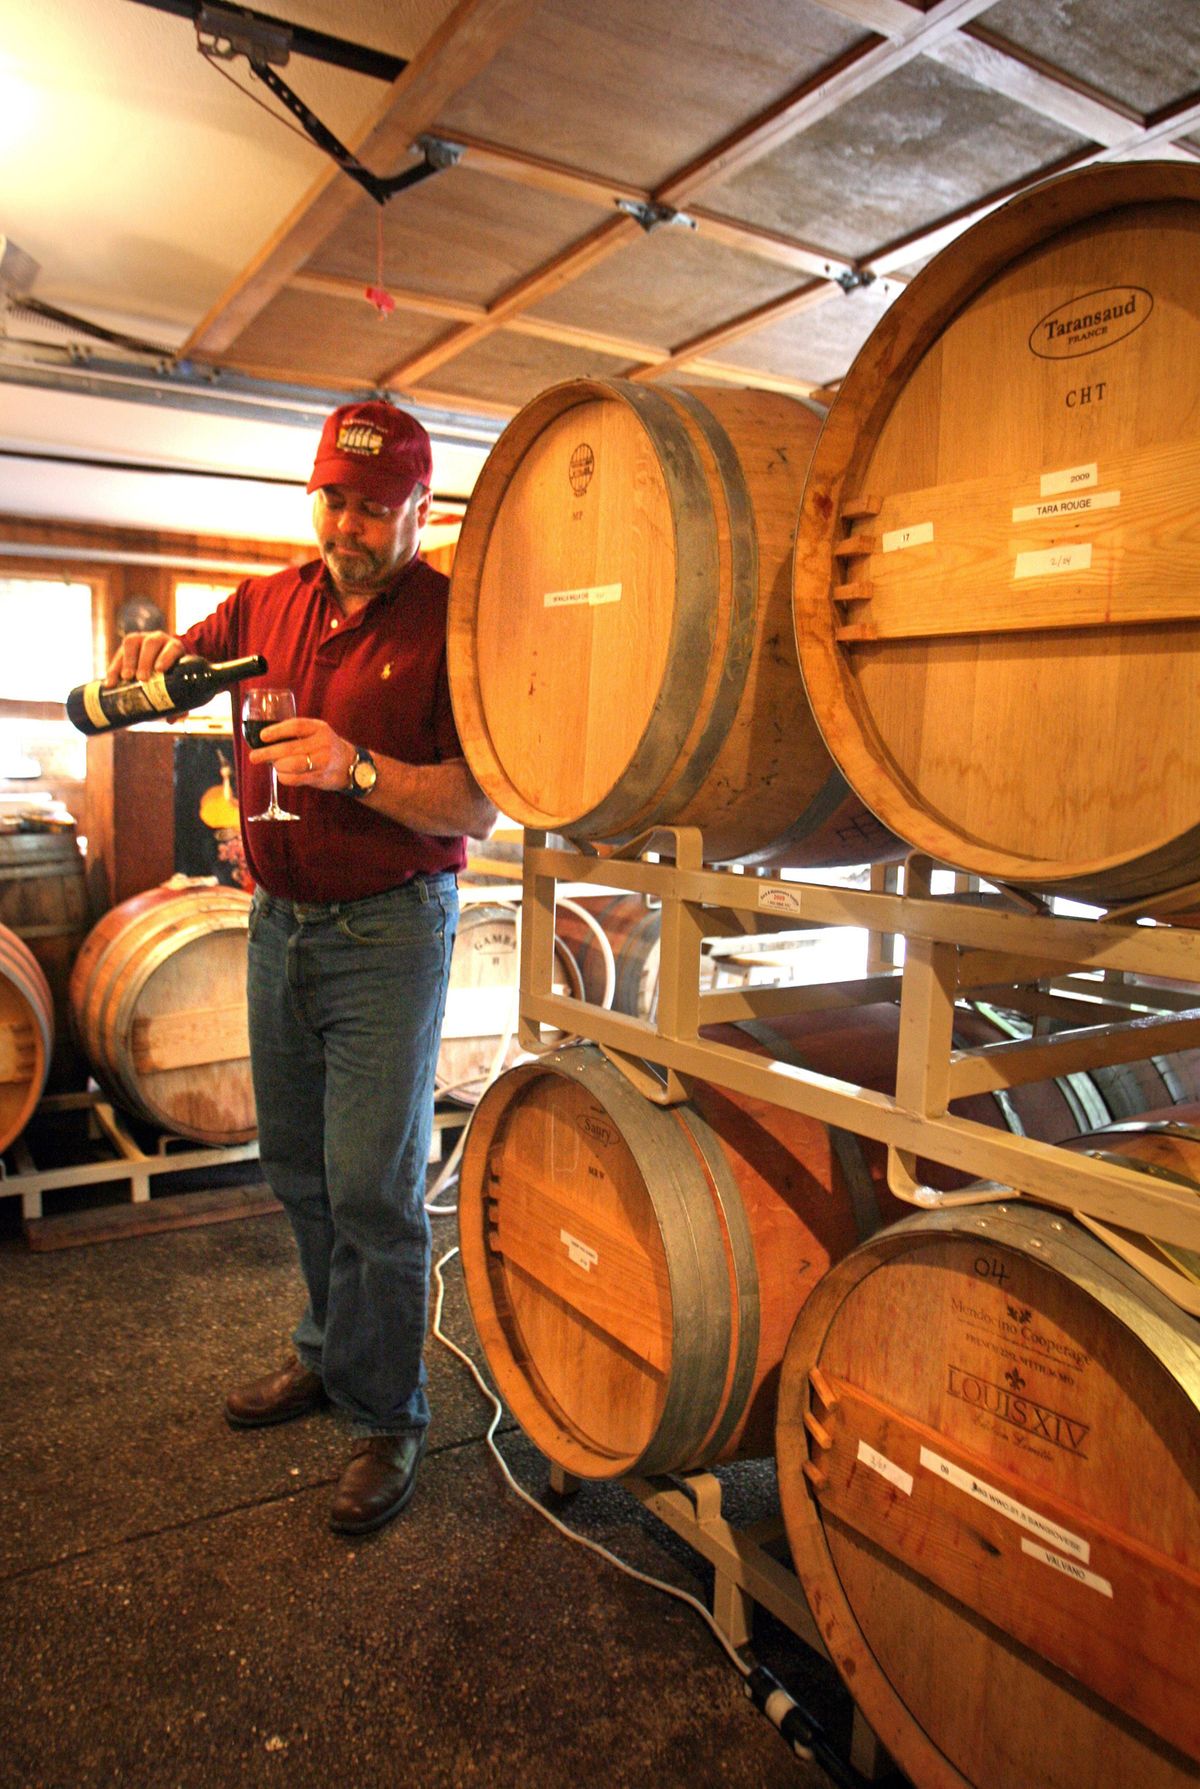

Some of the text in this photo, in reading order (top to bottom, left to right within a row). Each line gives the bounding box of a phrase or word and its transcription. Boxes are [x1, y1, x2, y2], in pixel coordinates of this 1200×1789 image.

[1043, 295, 1136, 341] Taransaud
[1068, 326, 1108, 344] FRANCE
[1070, 472, 1091, 483] 2009
[1037, 498, 1092, 516] TARA ROUGE
[584, 1118, 611, 1148] Saury
[974, 1257, 1010, 1286] 04
[951, 1298, 1018, 1335] Mendocino
[1020, 1326, 1091, 1367] Cooperage
[1045, 1551, 1086, 1580] VALVANO
